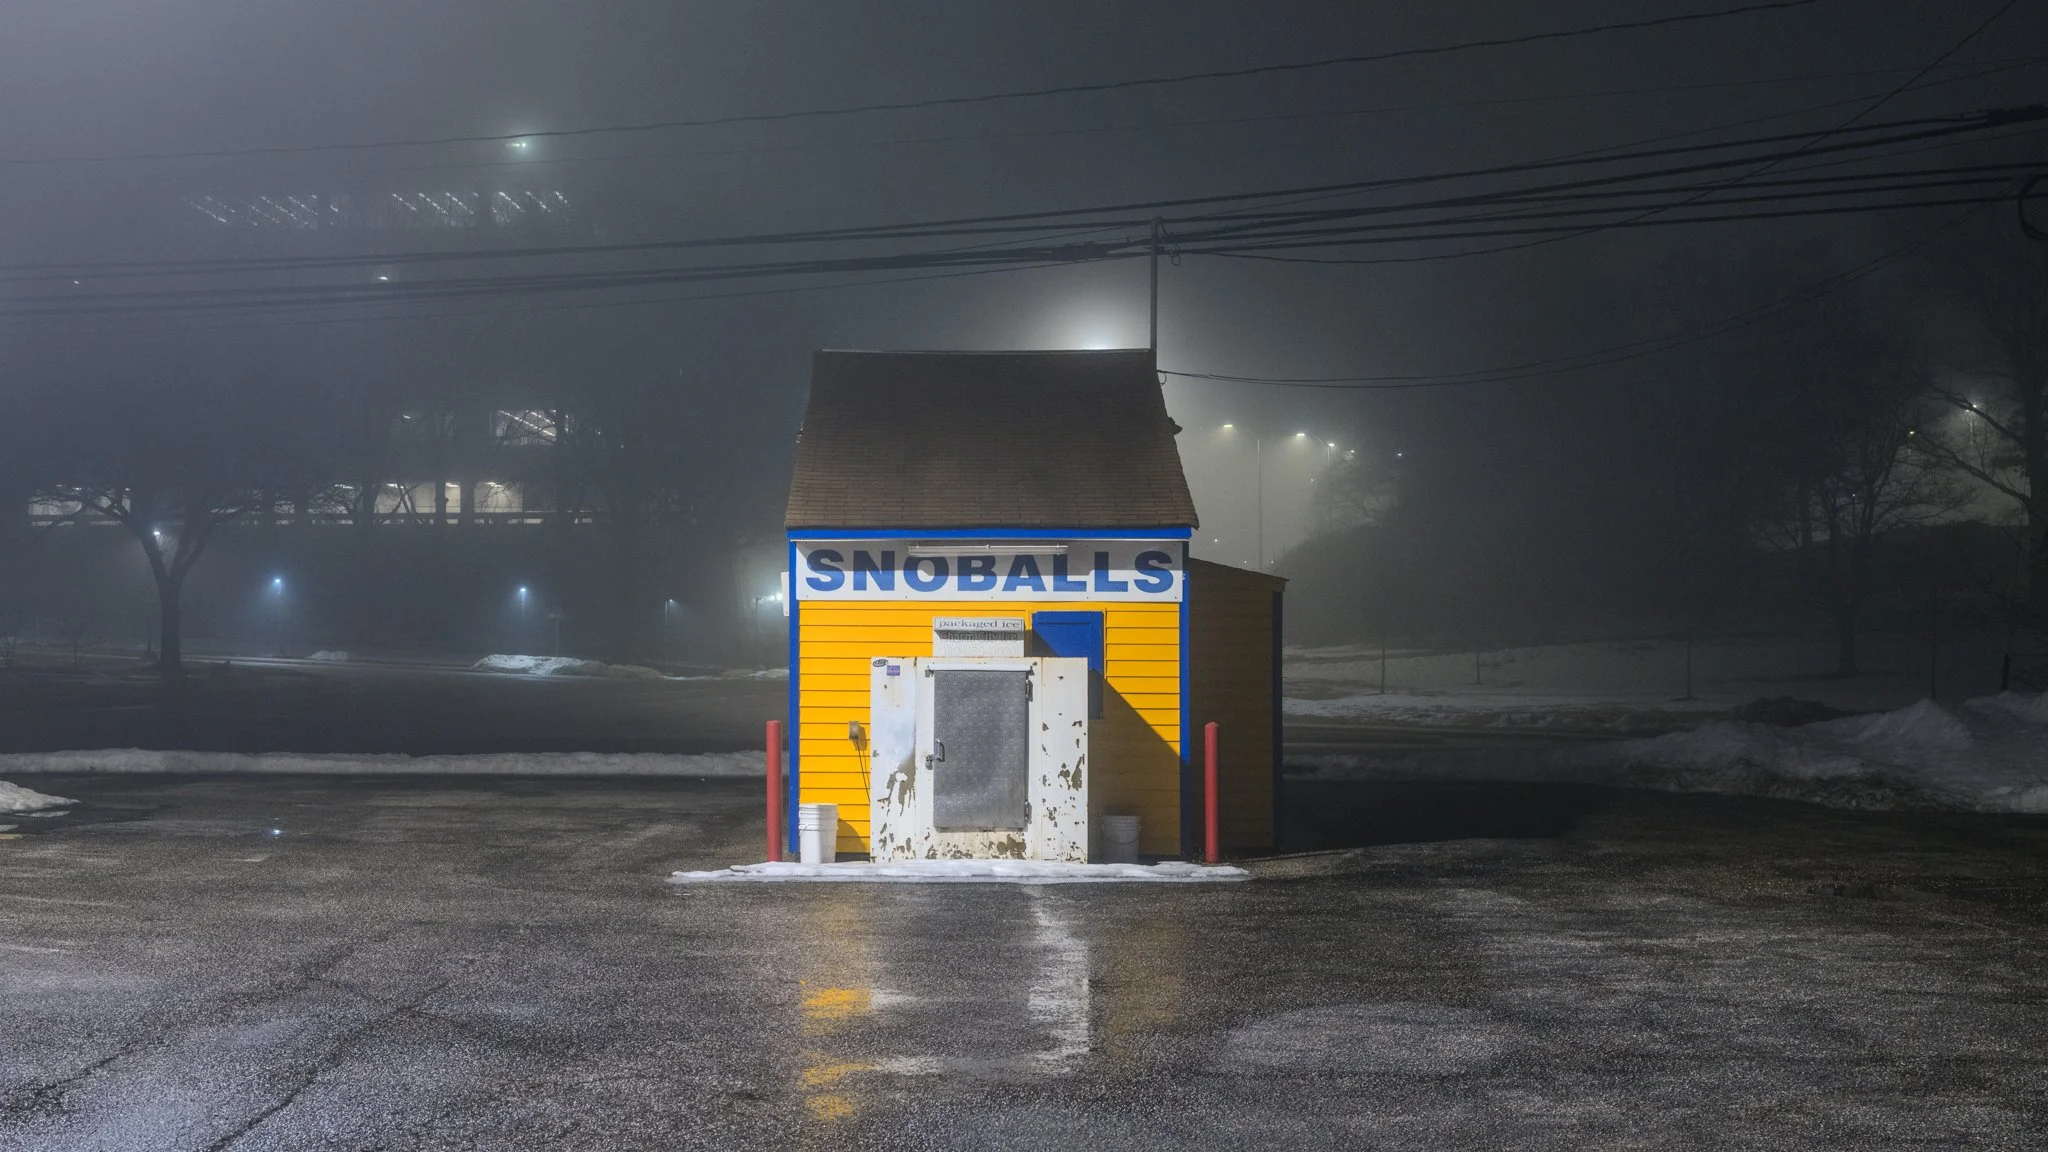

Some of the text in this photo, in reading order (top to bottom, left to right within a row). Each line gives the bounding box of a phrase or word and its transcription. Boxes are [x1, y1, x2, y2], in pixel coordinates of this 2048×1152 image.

[805, 549, 1174, 593] SNOBALLS
[939, 619, 1020, 629] packaged ice
